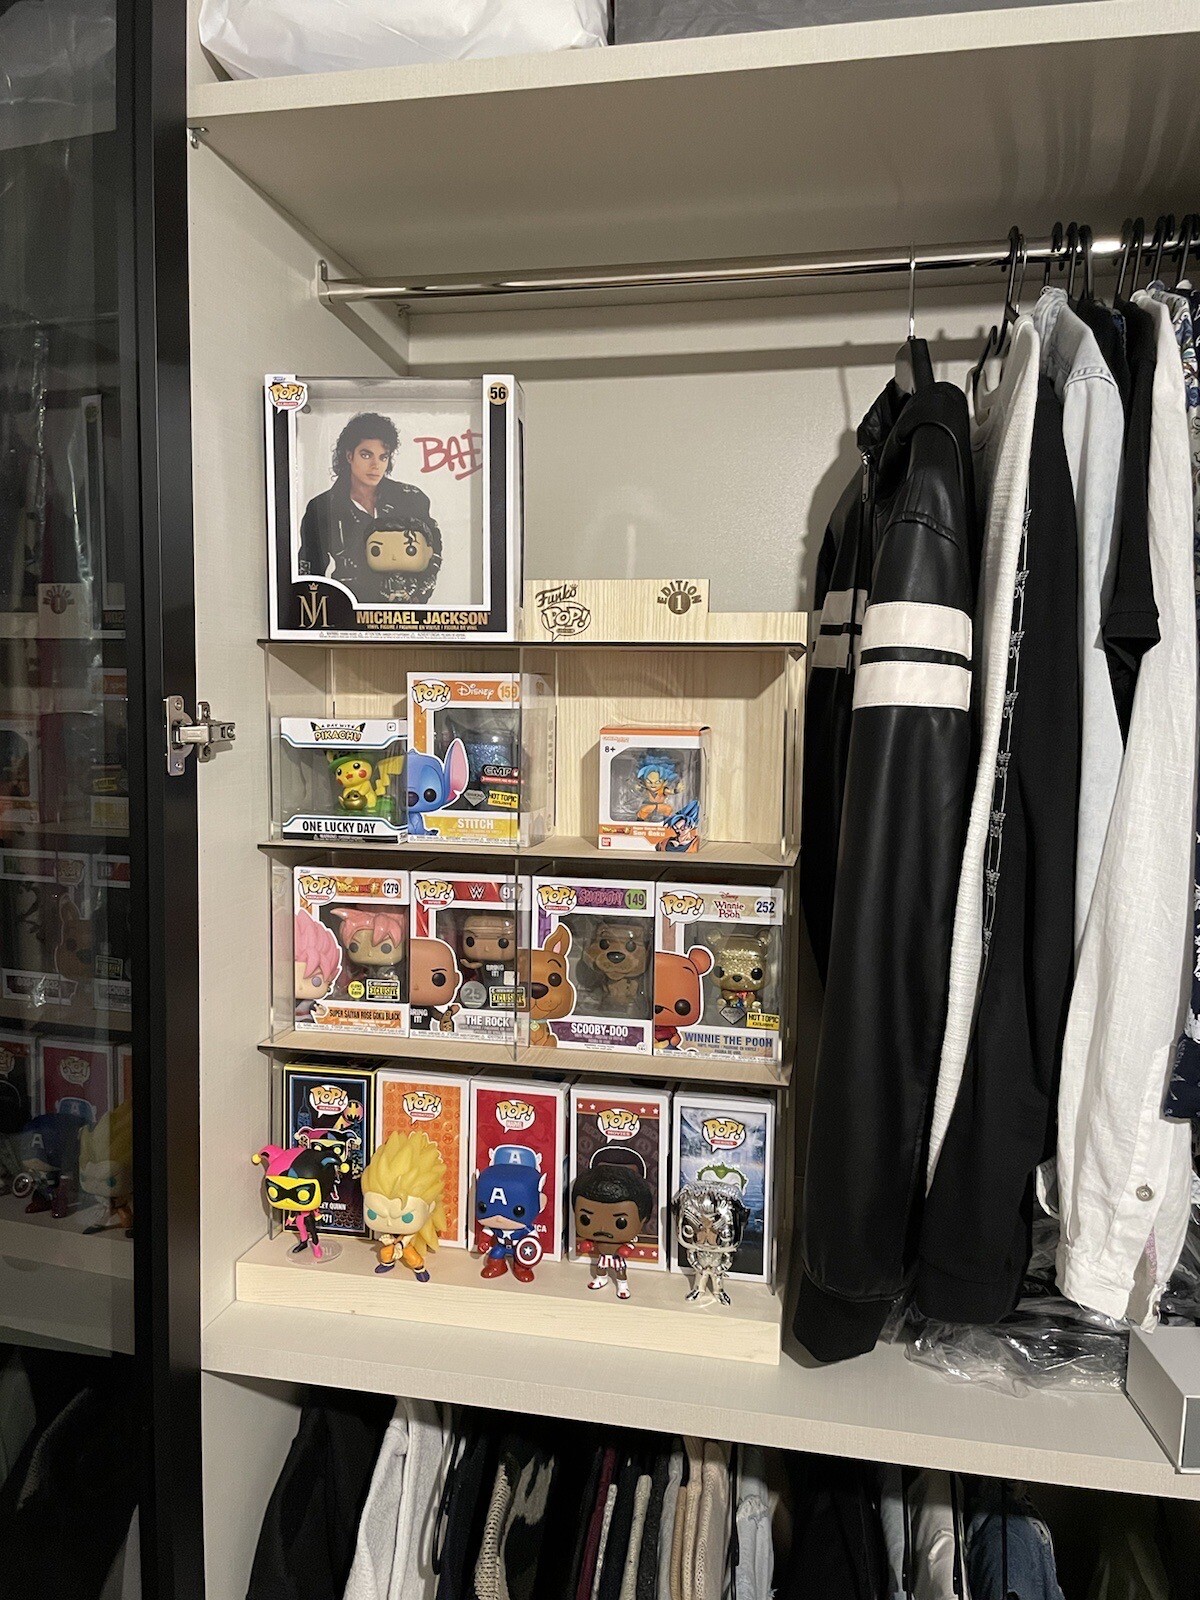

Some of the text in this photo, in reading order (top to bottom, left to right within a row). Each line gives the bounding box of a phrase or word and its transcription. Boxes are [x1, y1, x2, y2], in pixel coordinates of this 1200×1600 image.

[268, 383, 304, 402] POP!
[489, 386, 506, 400] 56
[535, 584, 577, 608] Funko
[657, 580, 702, 605] EDITION
[356, 611, 488, 625] MICHAEL JACKSON
[541, 606, 591, 629] POP!
[412, 681, 517, 703] POP! Disney 159
[314, 730, 362, 742] PIKACHU
[604, 745, 616, 753] 8+
[501, 794, 518, 803] TOPIC
[302, 820, 376, 834] ONE LUCKY DAY
[457, 818, 494, 830] STITCH
[298, 875, 337, 895] POP!
[383, 882, 399, 895] 1279
[414, 880, 454, 900] POP!
[537, 885, 576, 906] POP!
[627, 893, 644, 906] 149
[660, 894, 775, 915] POP! Winnie 252
[719, 908, 740, 918] Pooh
[368, 987, 398, 996] EXCLUSIVE
[464, 987, 481, 1000] 25
[492, 993, 524, 1003] EXCLUSE
[330, 1009, 343, 1018] SUPER
[344, 1010, 360, 1019] SAIYAN
[373, 1011, 385, 1020] GOKU
[385, 1012, 401, 1021] BLACK
[466, 1015, 510, 1027] THE ROCK
[748, 1013, 760, 1021] HOT
[761, 1015, 779, 1024] TOPIC
[571, 1023, 629, 1037] SCOOBY-DOO
[685, 1032, 773, 1048] WINNIE THE POOH
[310, 1086, 347, 1106] POP!
[402, 1092, 441, 1113] POP!
[495, 1100, 535, 1121] POP!
[597, 1109, 639, 1131] POP!
[702, 1119, 745, 1140] POP!
[509, 1150, 521, 1164] A
[490, 1187, 507, 1206] A
[329, 1202, 347, 1210] QUINN
